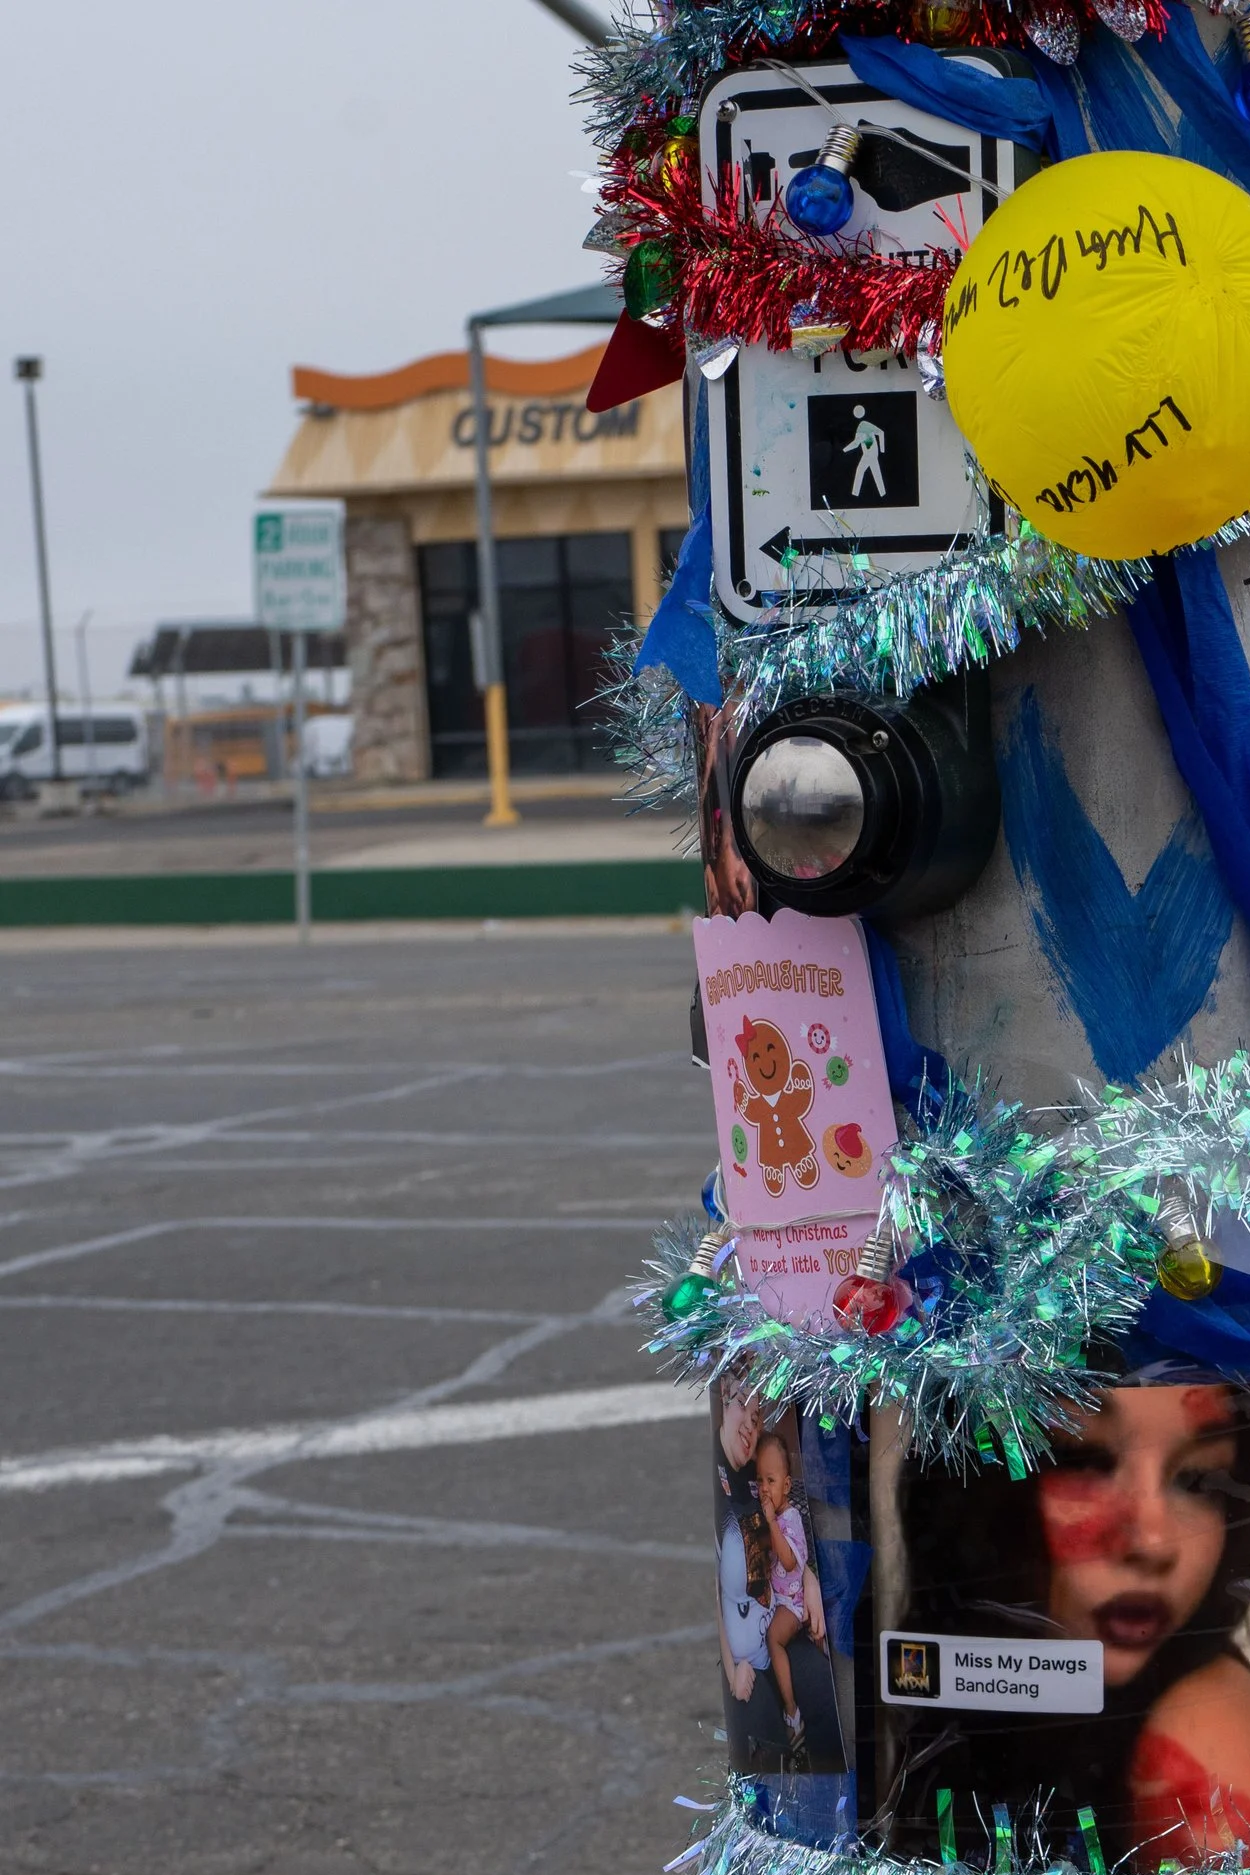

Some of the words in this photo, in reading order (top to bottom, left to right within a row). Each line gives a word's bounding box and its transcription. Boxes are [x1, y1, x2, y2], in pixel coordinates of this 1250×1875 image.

[452, 399, 641, 449] CUSTOM
[752, 1229, 782, 1249] Merry
[785, 1225, 848, 1243] Christmas
[750, 1256, 759, 1273] to
[762, 1258, 788, 1274] sweet
[792, 1256, 821, 1273] little
[954, 1652, 993, 1669] Miss
[997, 1655, 1023, 1673] My
[1028, 1656, 1088, 1674] Dawgs
[954, 1677, 1040, 1698] BandGang
